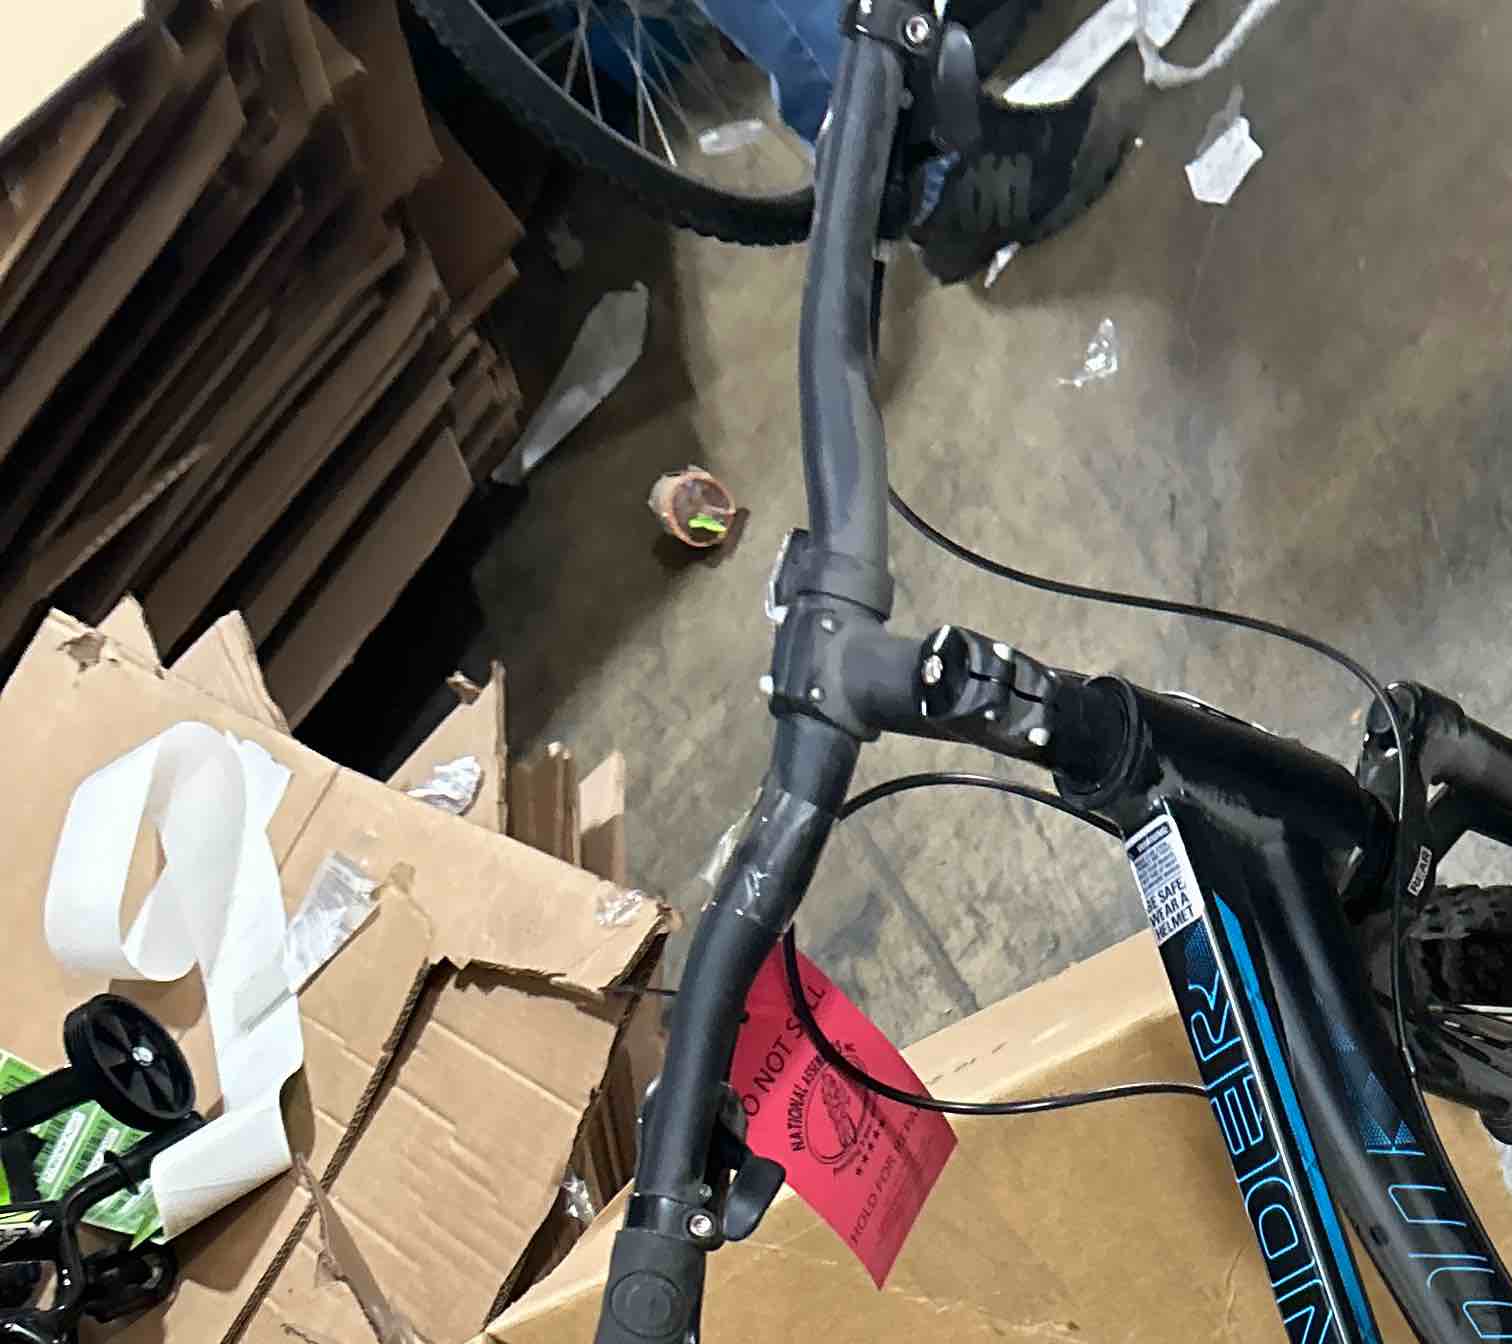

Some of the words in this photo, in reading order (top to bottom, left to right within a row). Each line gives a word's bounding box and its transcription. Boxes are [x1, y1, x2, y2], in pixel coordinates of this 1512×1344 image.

[1151, 899, 1180, 927] WEAR
[1180, 891, 1191, 906] A
[1156, 905, 1195, 941] HELMET
[753, 1034, 795, 1097] NOT
[786, 1083, 810, 1152] NATIONAL
[851, 1192, 877, 1245] HOLD
[874, 1151, 898, 1198] FOR
